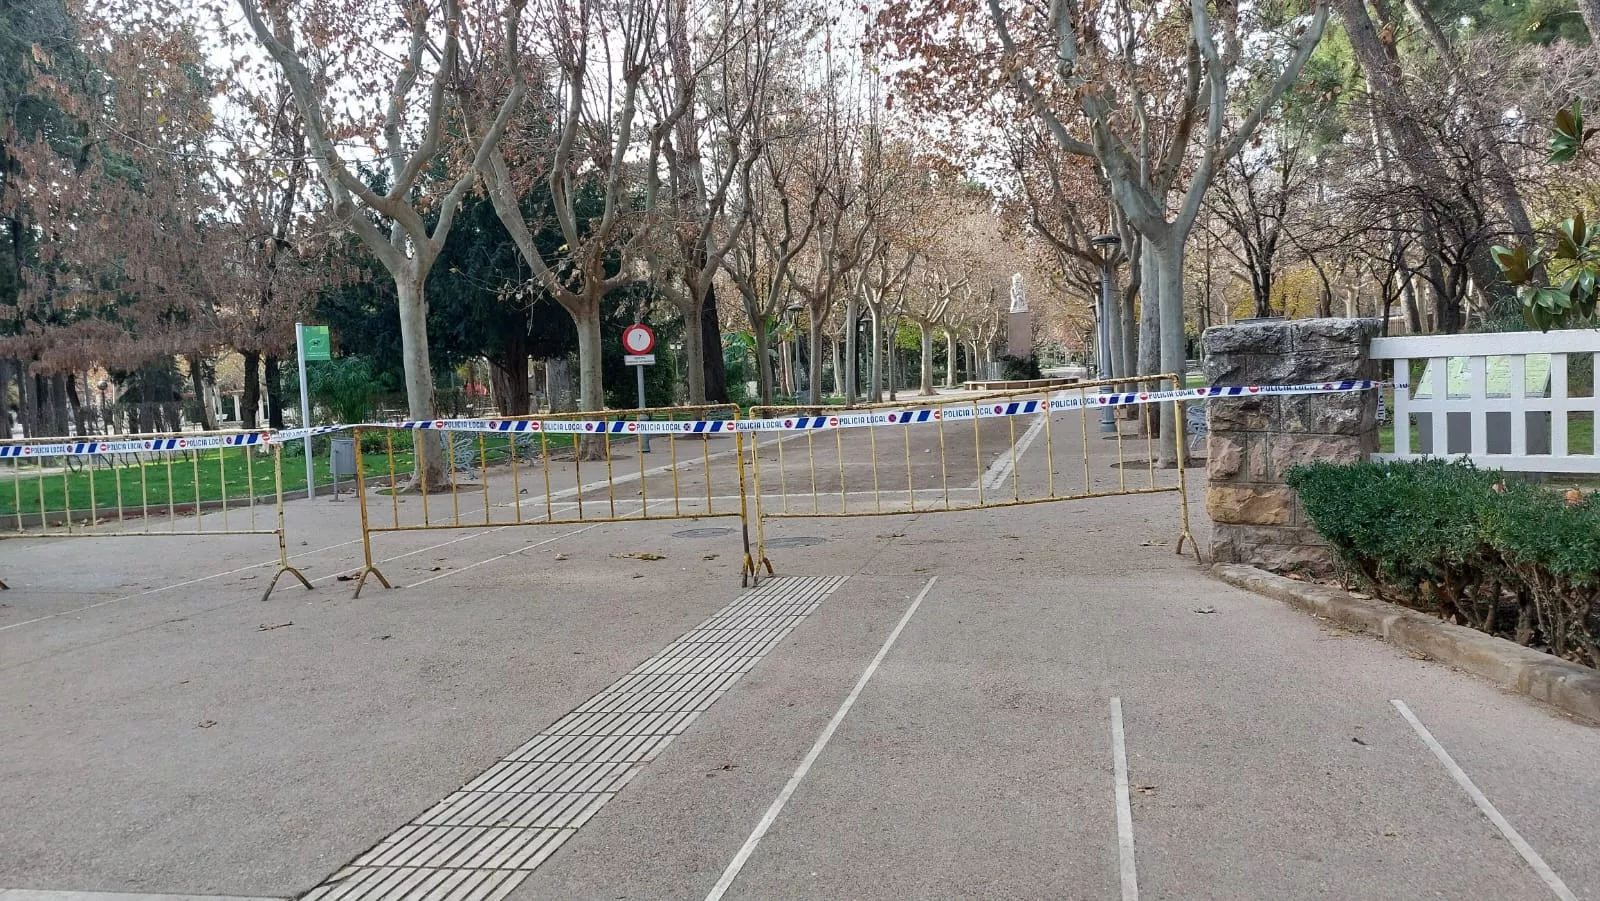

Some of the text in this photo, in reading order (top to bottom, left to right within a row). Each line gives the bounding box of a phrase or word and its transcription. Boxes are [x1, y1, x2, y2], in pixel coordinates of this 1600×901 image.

[1050, 397, 1099, 408] POLICIA LOCAL
[943, 408, 970, 418] POLICIA
[735, 420, 782, 430] POLICIA LOCAL
[839, 415, 886, 426] POLICIA LOCAL
[564, 423, 584, 431] LOCAL
[636, 423, 682, 431] POLICIA LOCAL
